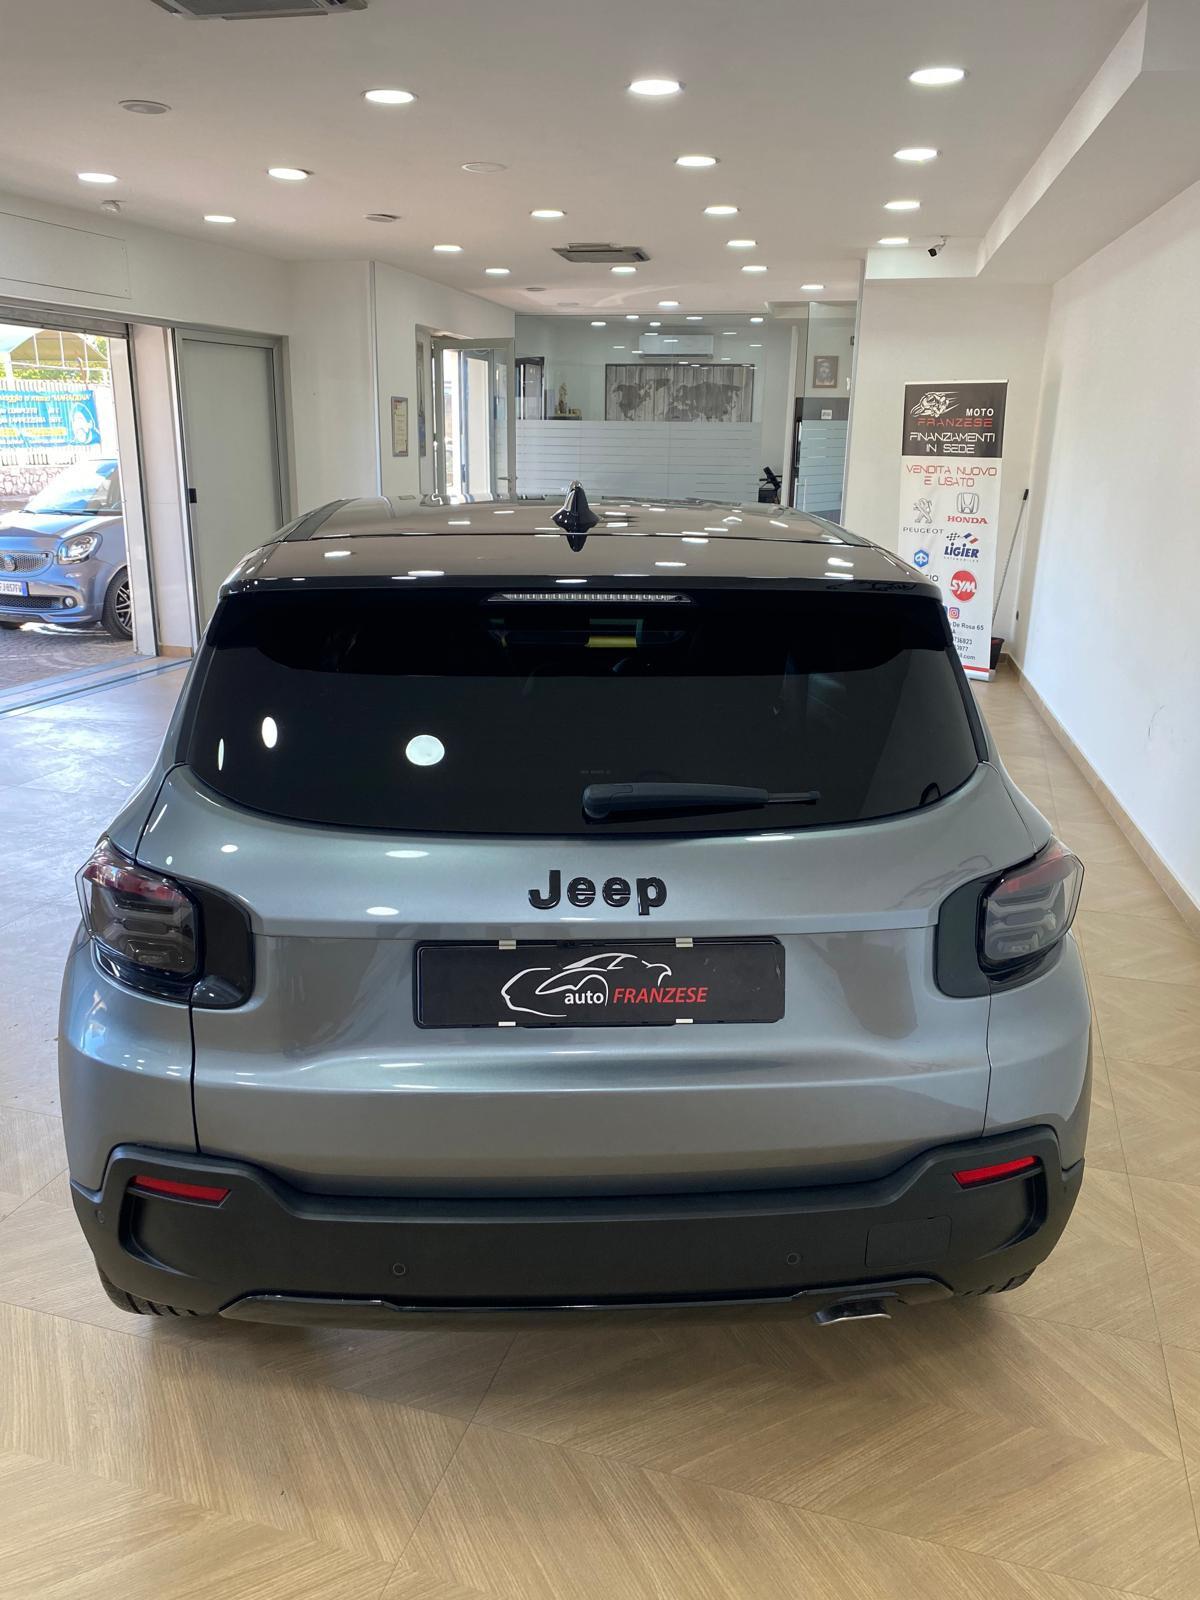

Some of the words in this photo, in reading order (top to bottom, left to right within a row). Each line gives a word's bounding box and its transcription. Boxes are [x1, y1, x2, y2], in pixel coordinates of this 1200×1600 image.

[966, 408, 994, 416] MOTO
[917, 418, 993, 428] FRANZESE
[910, 432, 995, 442] FINANZIAMENTI
[926, 443, 937, 453] IN
[943, 444, 975, 453] SEDE
[906, 464, 951, 475] VENDITA
[957, 466, 997, 476] NUOVO
[924, 475, 932, 485] E
[938, 476, 974, 487] USATO
[947, 515, 988, 524] HONDA
[950, 579, 976, 594] SYM
[528, 870, 667, 916] Jeep
[564, 990, 604, 1005] auto
[613, 987, 709, 1004] FRANZESE
